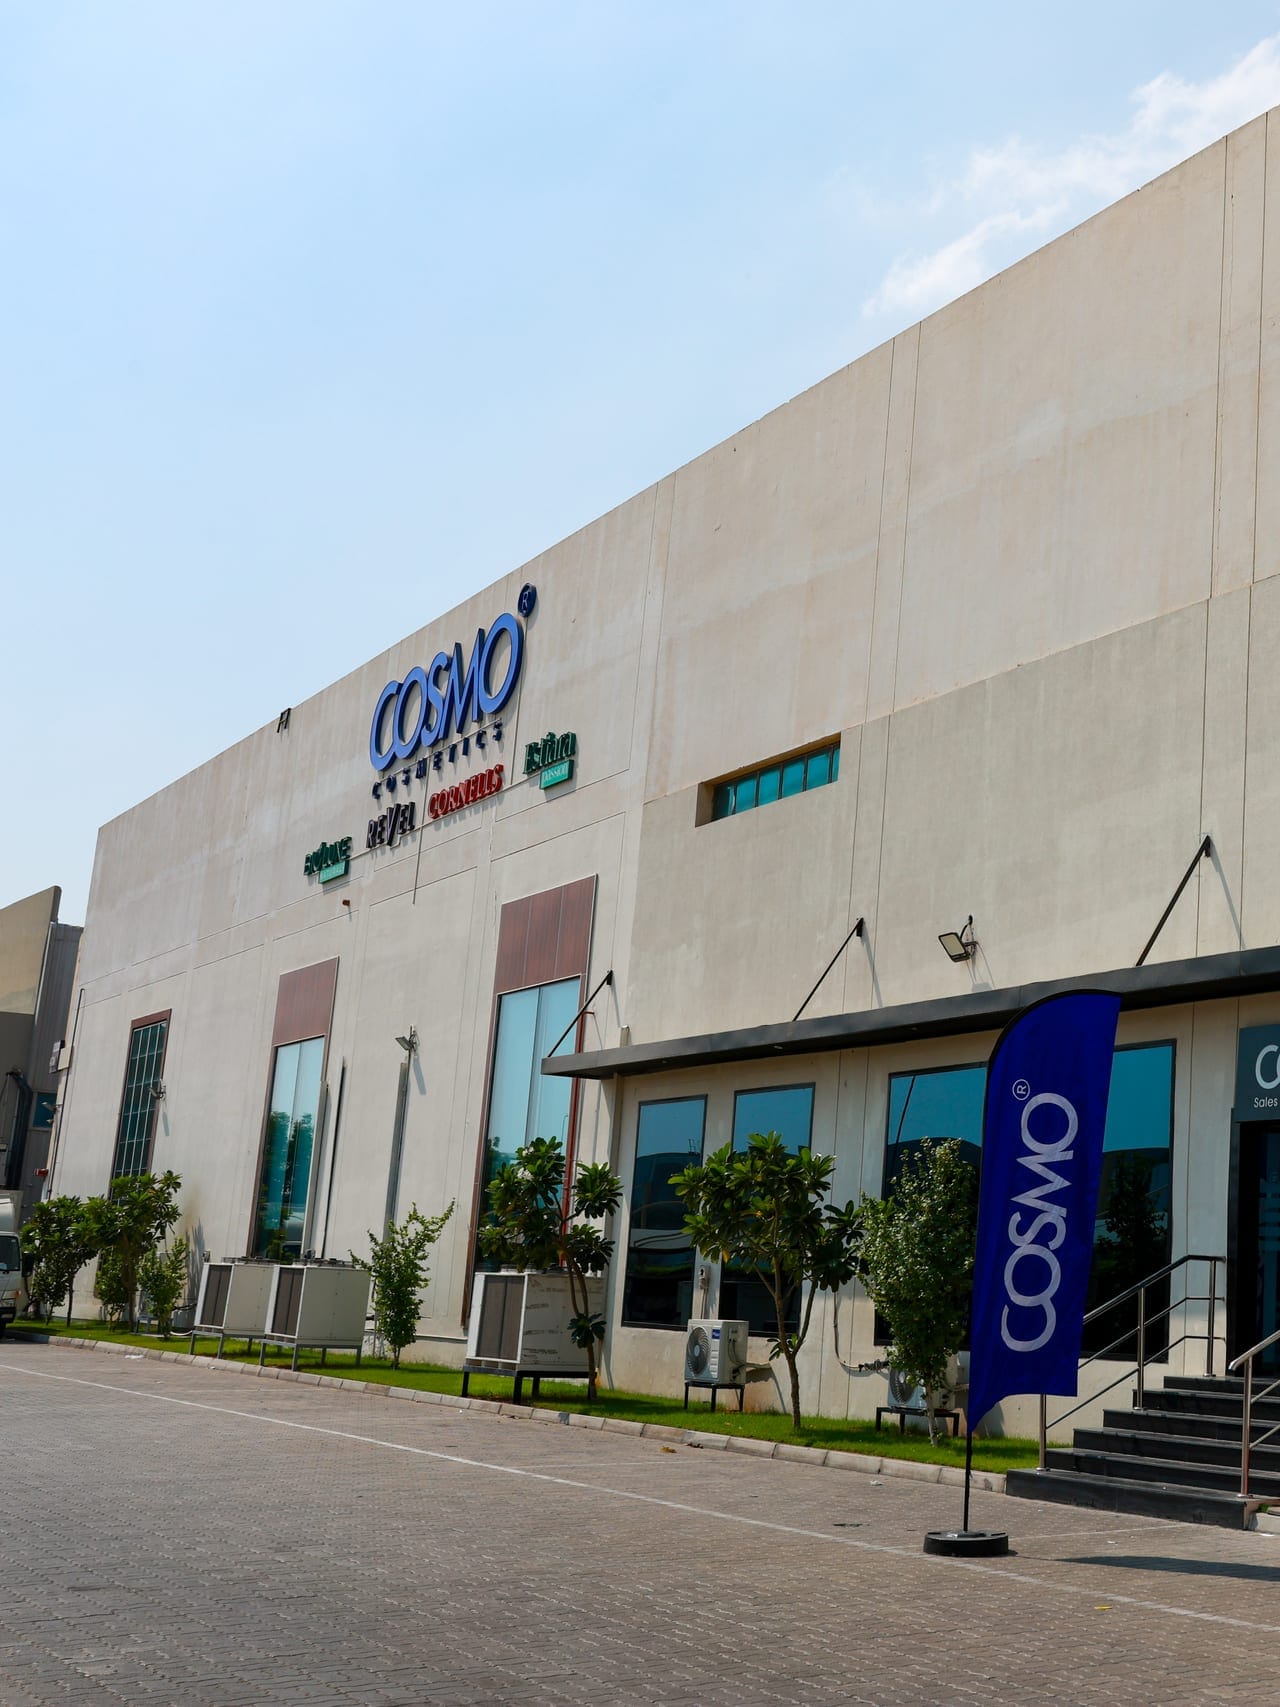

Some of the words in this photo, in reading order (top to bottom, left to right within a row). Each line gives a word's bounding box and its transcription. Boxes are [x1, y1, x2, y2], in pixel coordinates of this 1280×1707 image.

[369, 612, 524, 771] COSMO
[372, 720, 502, 800] COSMETICS
[1253, 1095, 1278, 1108] Sales
[1000, 1092, 1079, 1352] COSMO
